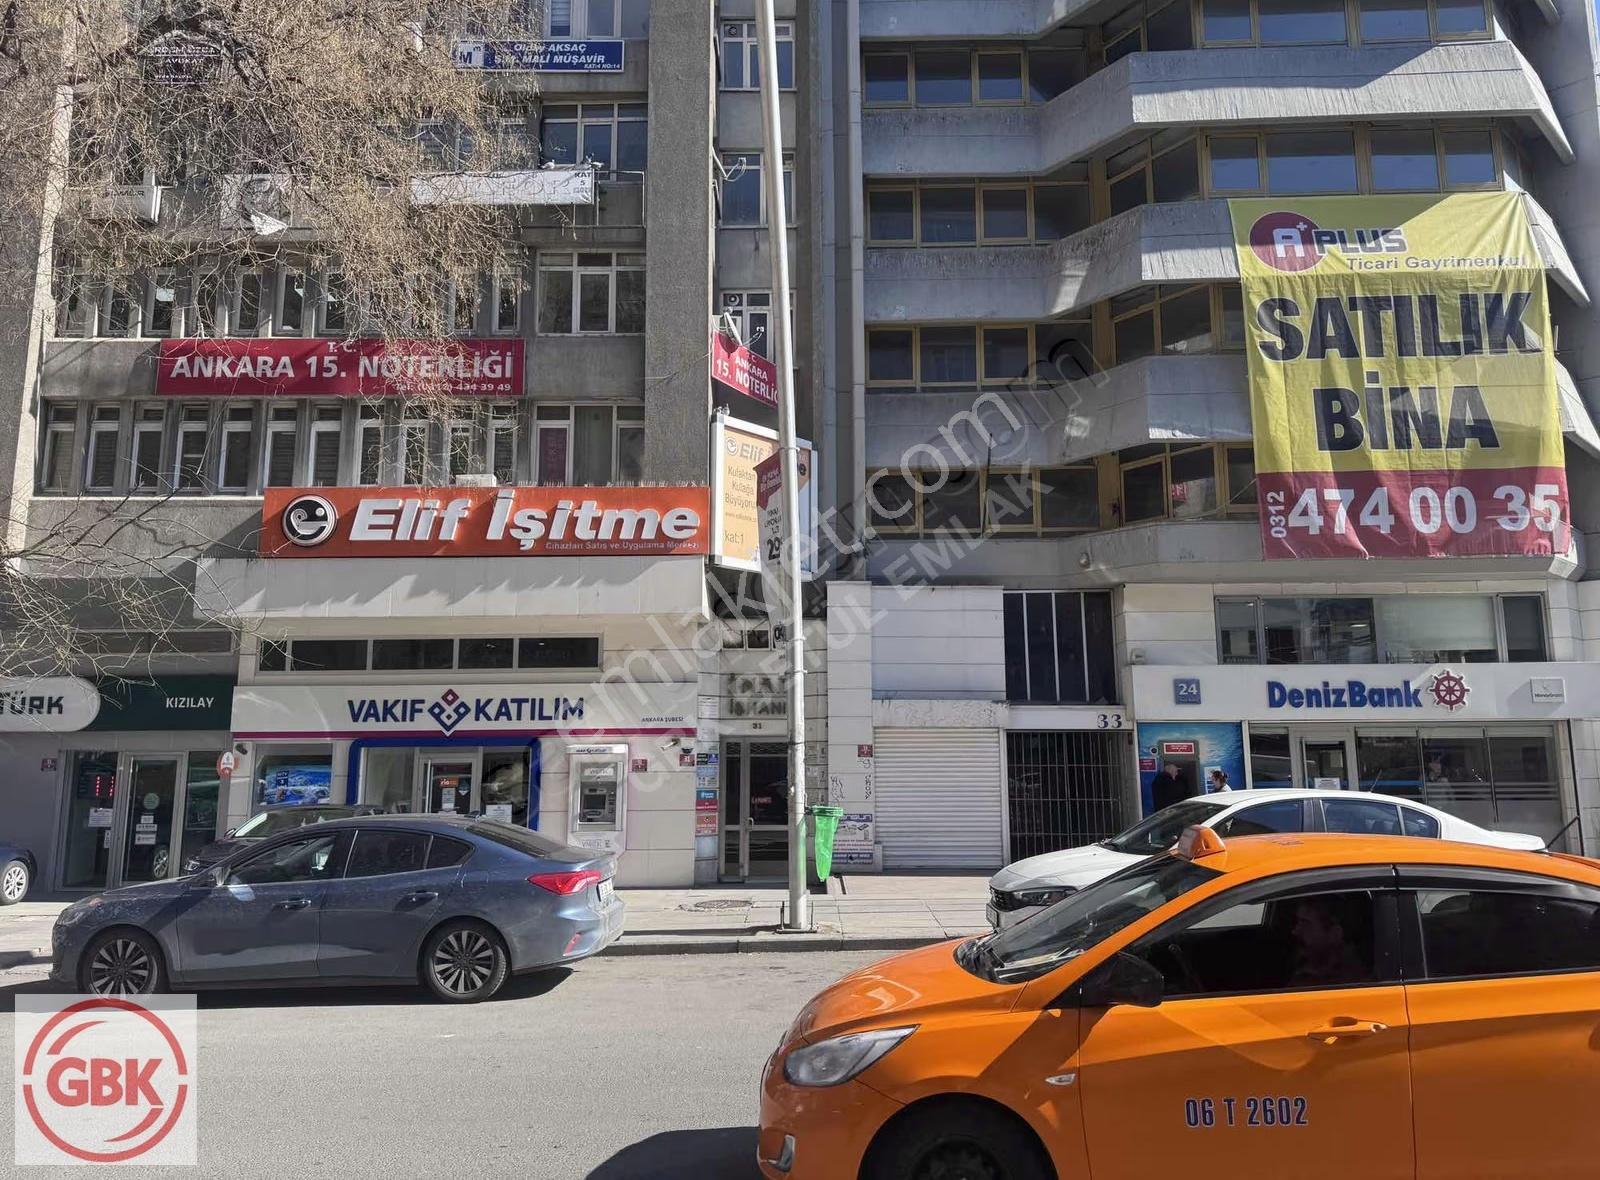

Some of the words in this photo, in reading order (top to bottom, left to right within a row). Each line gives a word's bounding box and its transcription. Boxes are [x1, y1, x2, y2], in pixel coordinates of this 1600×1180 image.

[522, 53, 549, 64] MALİ
[553, 54, 605, 65] MÜŞAVİR
[548, 43, 587, 52] AKSAÇ
[1311, 228, 1408, 255] PLUS
[1346, 257, 1399, 271] Ticari
[1405, 255, 1526, 274] Gayrimenkul
[1256, 292, 1536, 363] SATILIK
[170, 356, 294, 378] ANKARA
[306, 356, 346, 378] 15.
[358, 350, 513, 378] NOTERLİĞİ
[716, 359, 732, 379] 15.
[735, 355, 768, 382] ANKARA
[1312, 370, 1501, 452] BİNA
[740, 443, 762, 462] Elif
[349, 498, 472, 540] Elif
[486, 488, 702, 550] İşitme
[1267, 490, 1287, 538] 0312
[1288, 487, 1395, 535] 474
[1408, 486, 1477, 534] 00
[1492, 483, 1561, 532] 35
[586, 541, 608, 550] Satış
[622, 542, 665, 551] Uygulama
[1179, 683, 1198, 695] 24
[1267, 680, 1423, 708] DenizBank
[166, 697, 214, 708] KIZILAY
[348, 699, 425, 722] VAKIF
[475, 697, 584, 721] KATILIM
[1097, 714, 1123, 729] 33
[1184, 1098, 1216, 1128] 06
[1222, 1096, 1237, 1127] T
[1246, 1095, 1309, 1127] 2602
